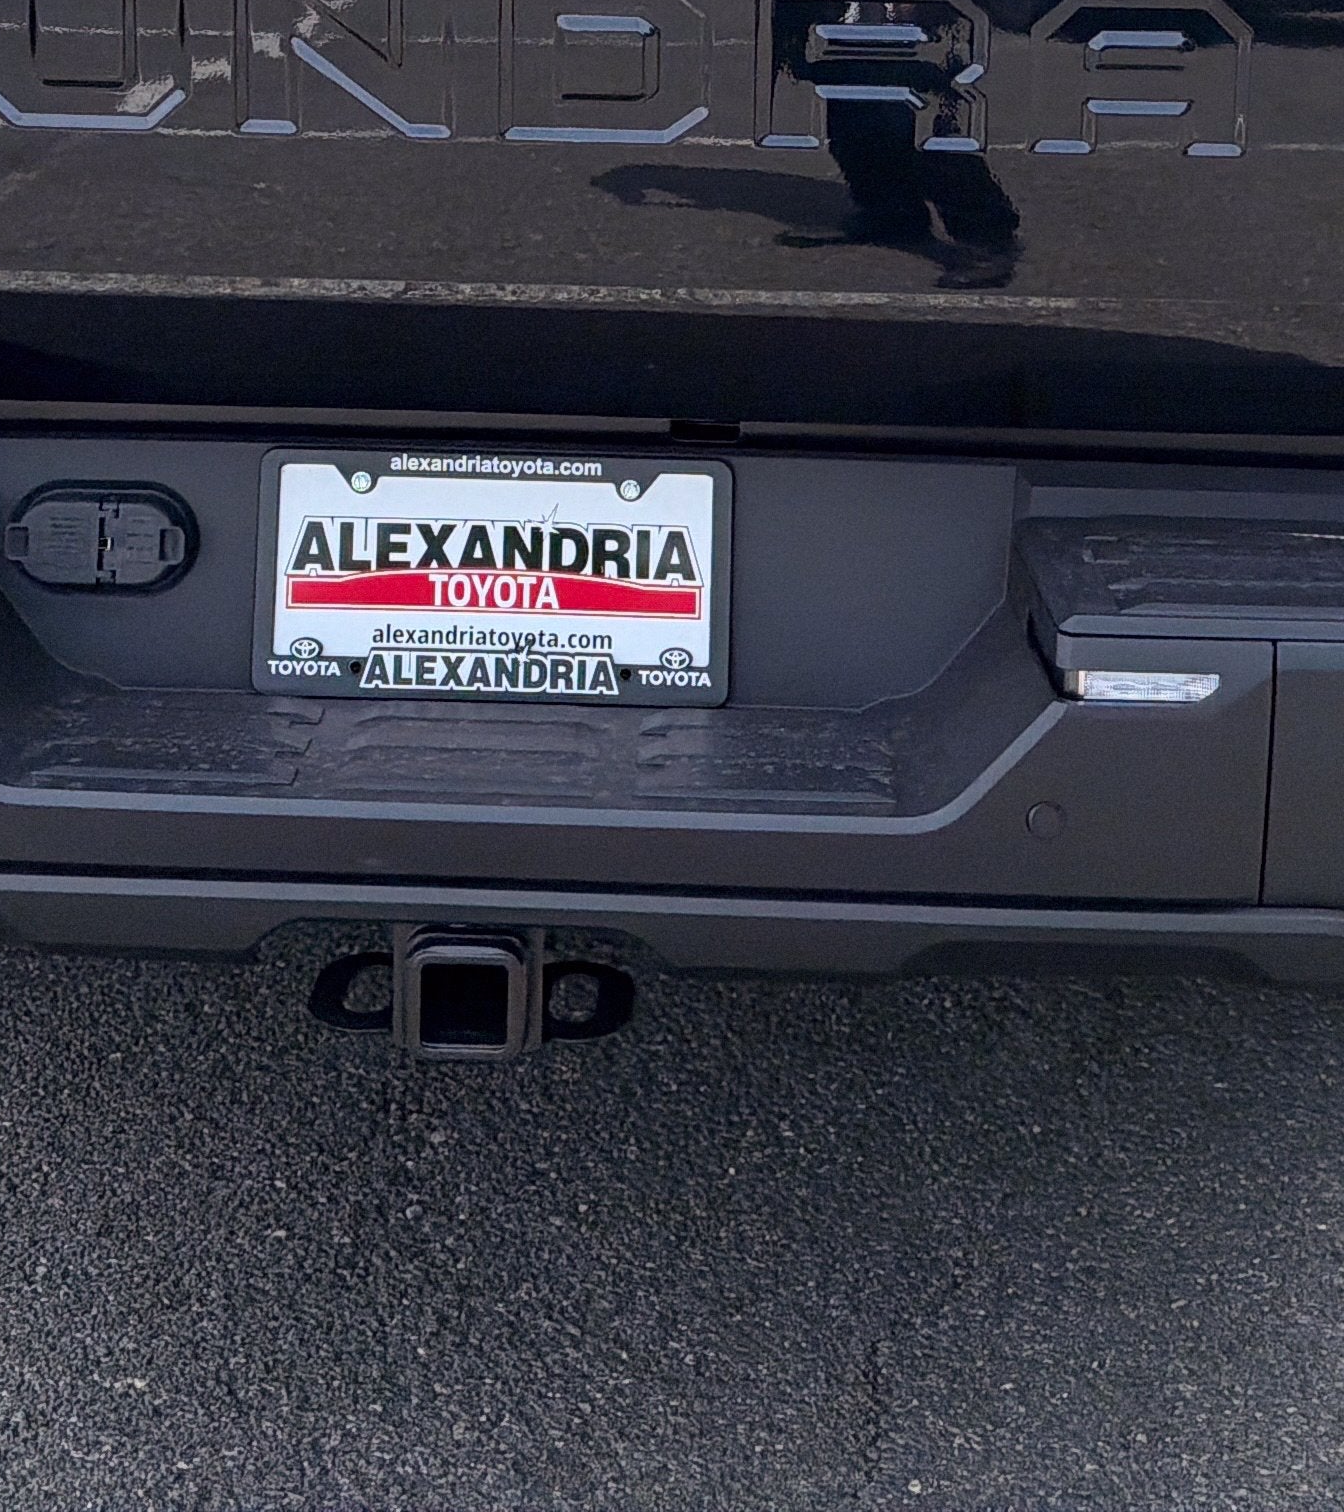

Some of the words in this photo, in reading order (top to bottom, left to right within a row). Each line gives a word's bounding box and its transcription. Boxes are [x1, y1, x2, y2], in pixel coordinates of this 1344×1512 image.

[389, 454, 602, 478] alexandriatoyota.com
[288, 519, 704, 583] ALEXANDRIA
[428, 573, 560, 610] TOYOTA
[371, 624, 613, 651] alexandriatoyota.com
[267, 660, 342, 677] TOYOTA
[361, 650, 618, 694] ALEXANDRIA
[638, 670, 712, 688] TOYOTA
